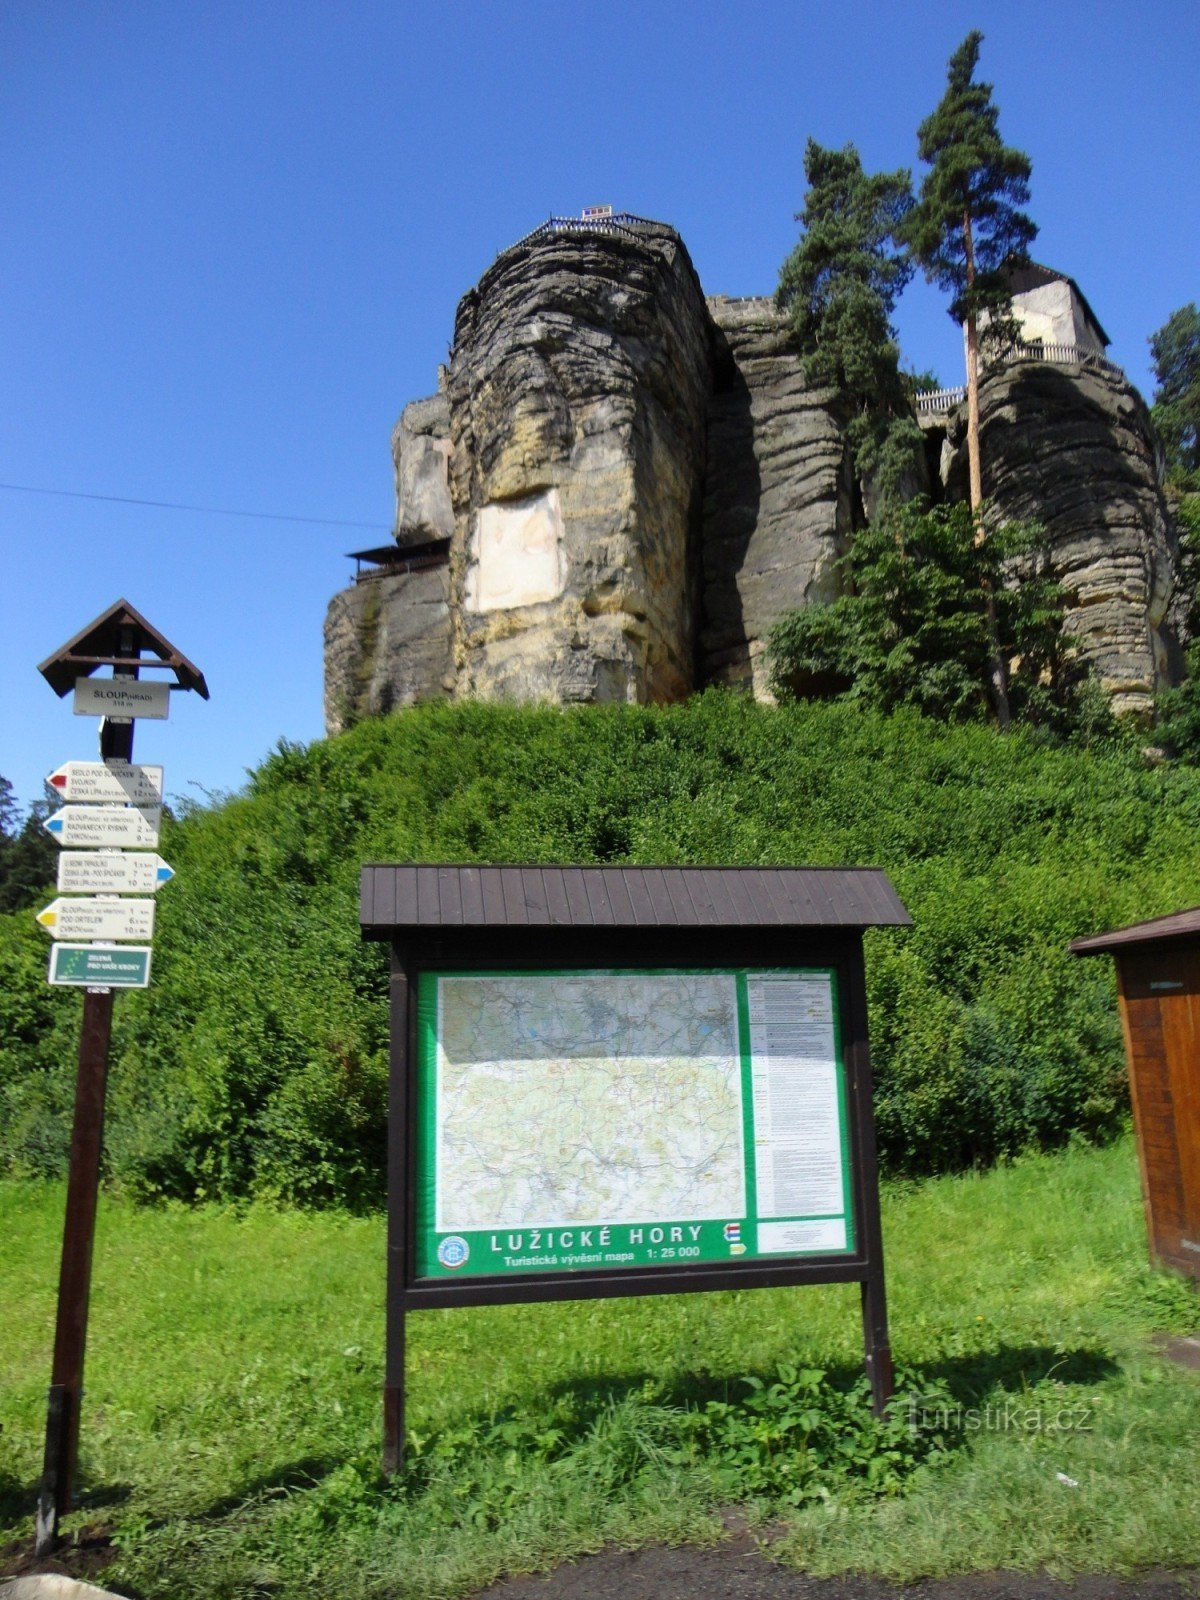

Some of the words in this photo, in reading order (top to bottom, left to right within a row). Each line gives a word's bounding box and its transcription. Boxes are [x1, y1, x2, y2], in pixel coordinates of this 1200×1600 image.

[491, 1226, 611, 1252] LUŽICKÉ
[629, 1225, 702, 1244] HORY
[504, 1254, 558, 1267] Turistická
[561, 1252, 602, 1265] vývěsní
[605, 1252, 635, 1263] mapa
[661, 1247, 676, 1258] 25
[678, 1246, 700, 1256] 000
